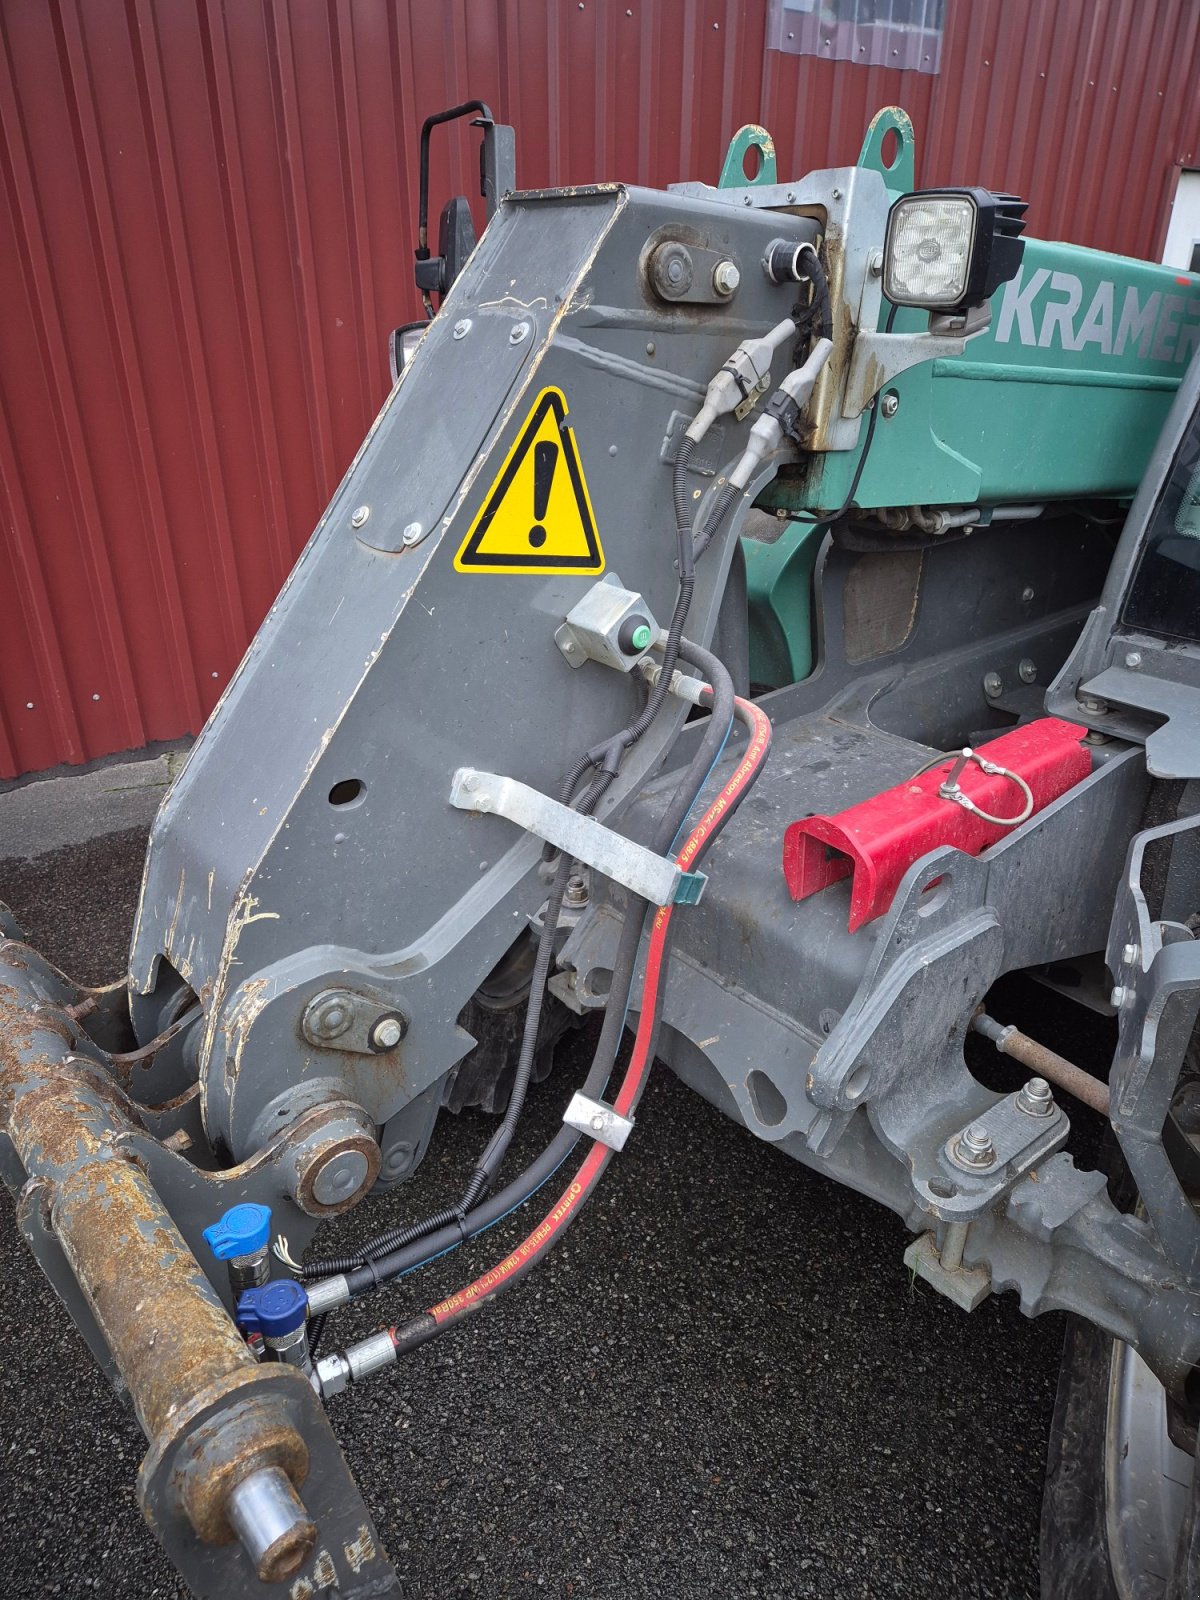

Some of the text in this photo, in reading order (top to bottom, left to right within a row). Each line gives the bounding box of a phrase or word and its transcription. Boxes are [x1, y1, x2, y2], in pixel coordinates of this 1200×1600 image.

[995, 264, 1200, 363] KRAMER
[749, 745, 761, 762] Anti
[726, 760, 753, 796] Abrasion
[681, 826, 707, 863] IC-188/5
[552, 1191, 576, 1222] PIRTEK
[520, 1223, 551, 1256] PFM35-08
[465, 1285, 481, 1299] WP
